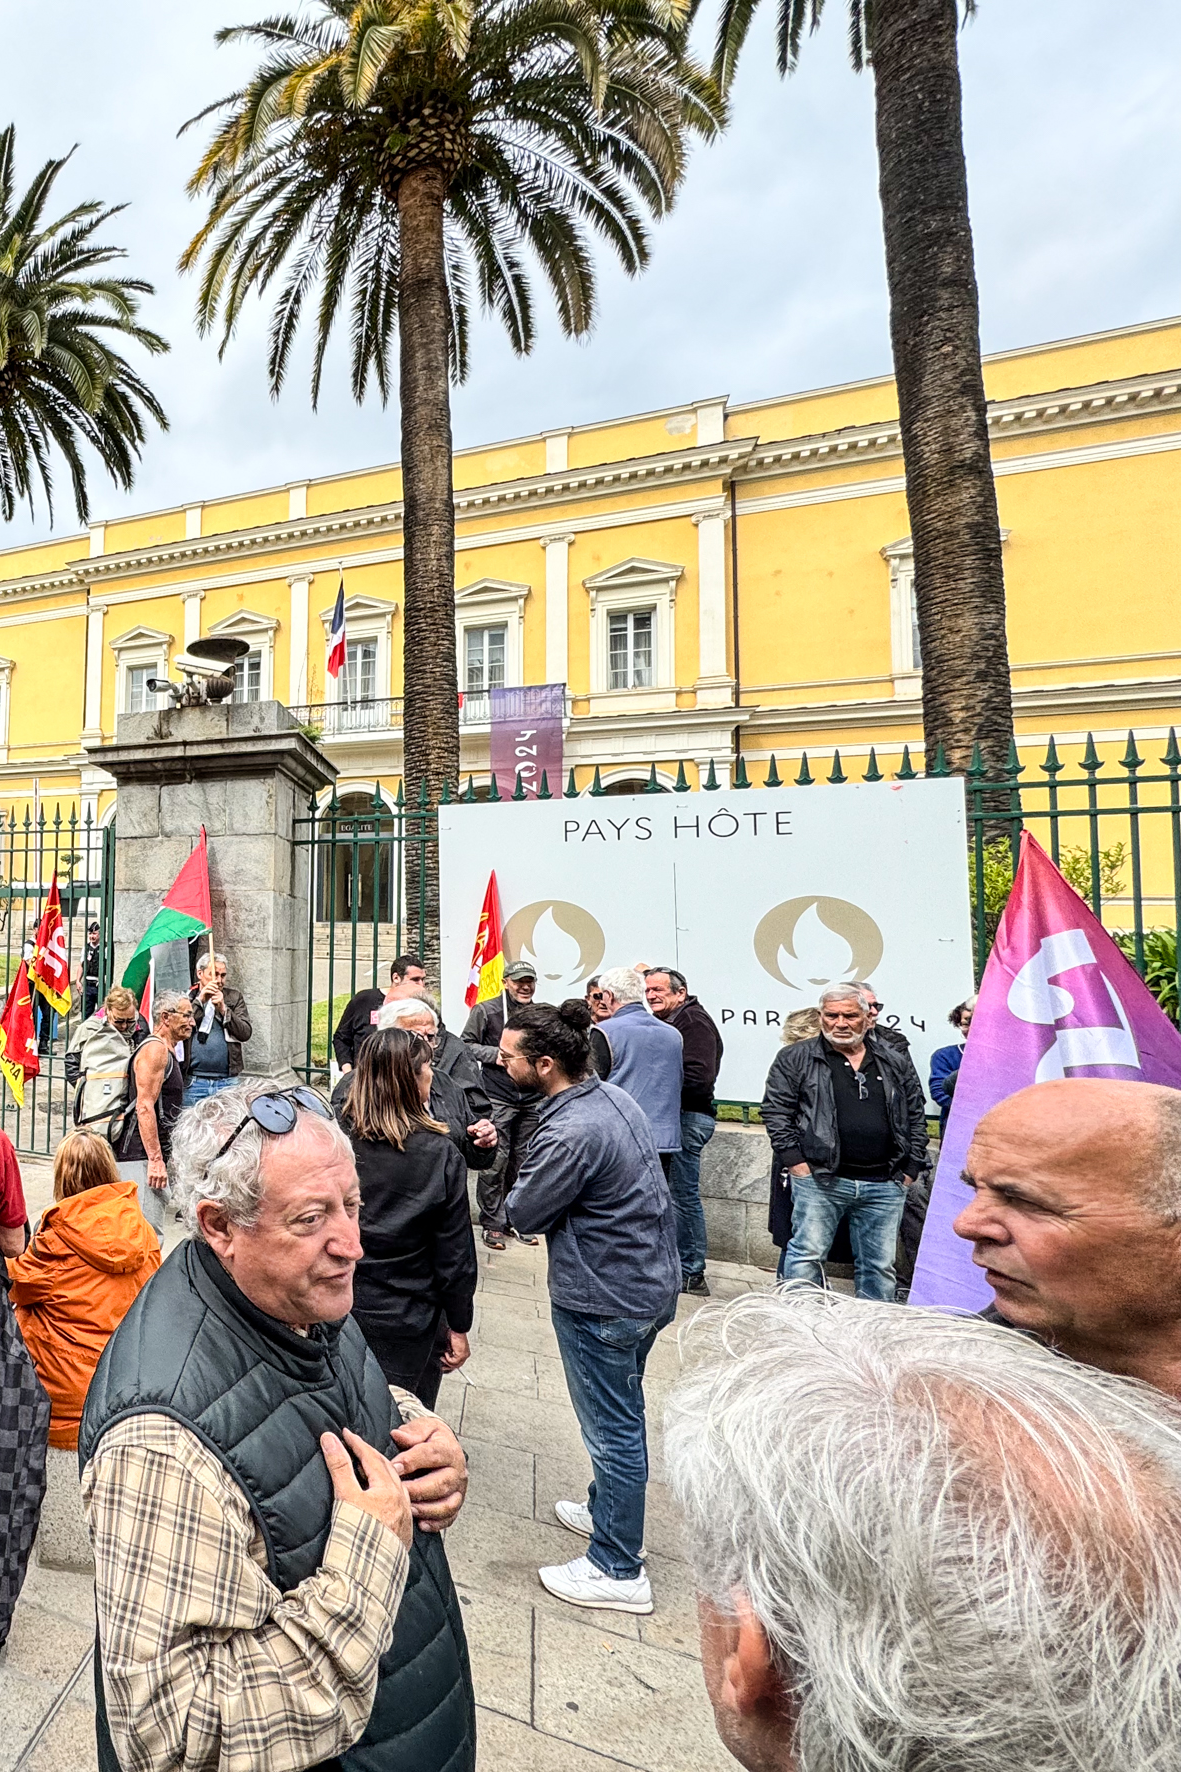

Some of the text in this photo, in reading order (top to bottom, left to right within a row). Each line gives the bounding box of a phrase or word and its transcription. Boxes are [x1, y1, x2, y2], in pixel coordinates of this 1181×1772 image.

[515, 729, 537, 793] 2024
[564, 807, 793, 842] PAYS HÔTE
[722, 1008, 927, 1033] PAR 24
